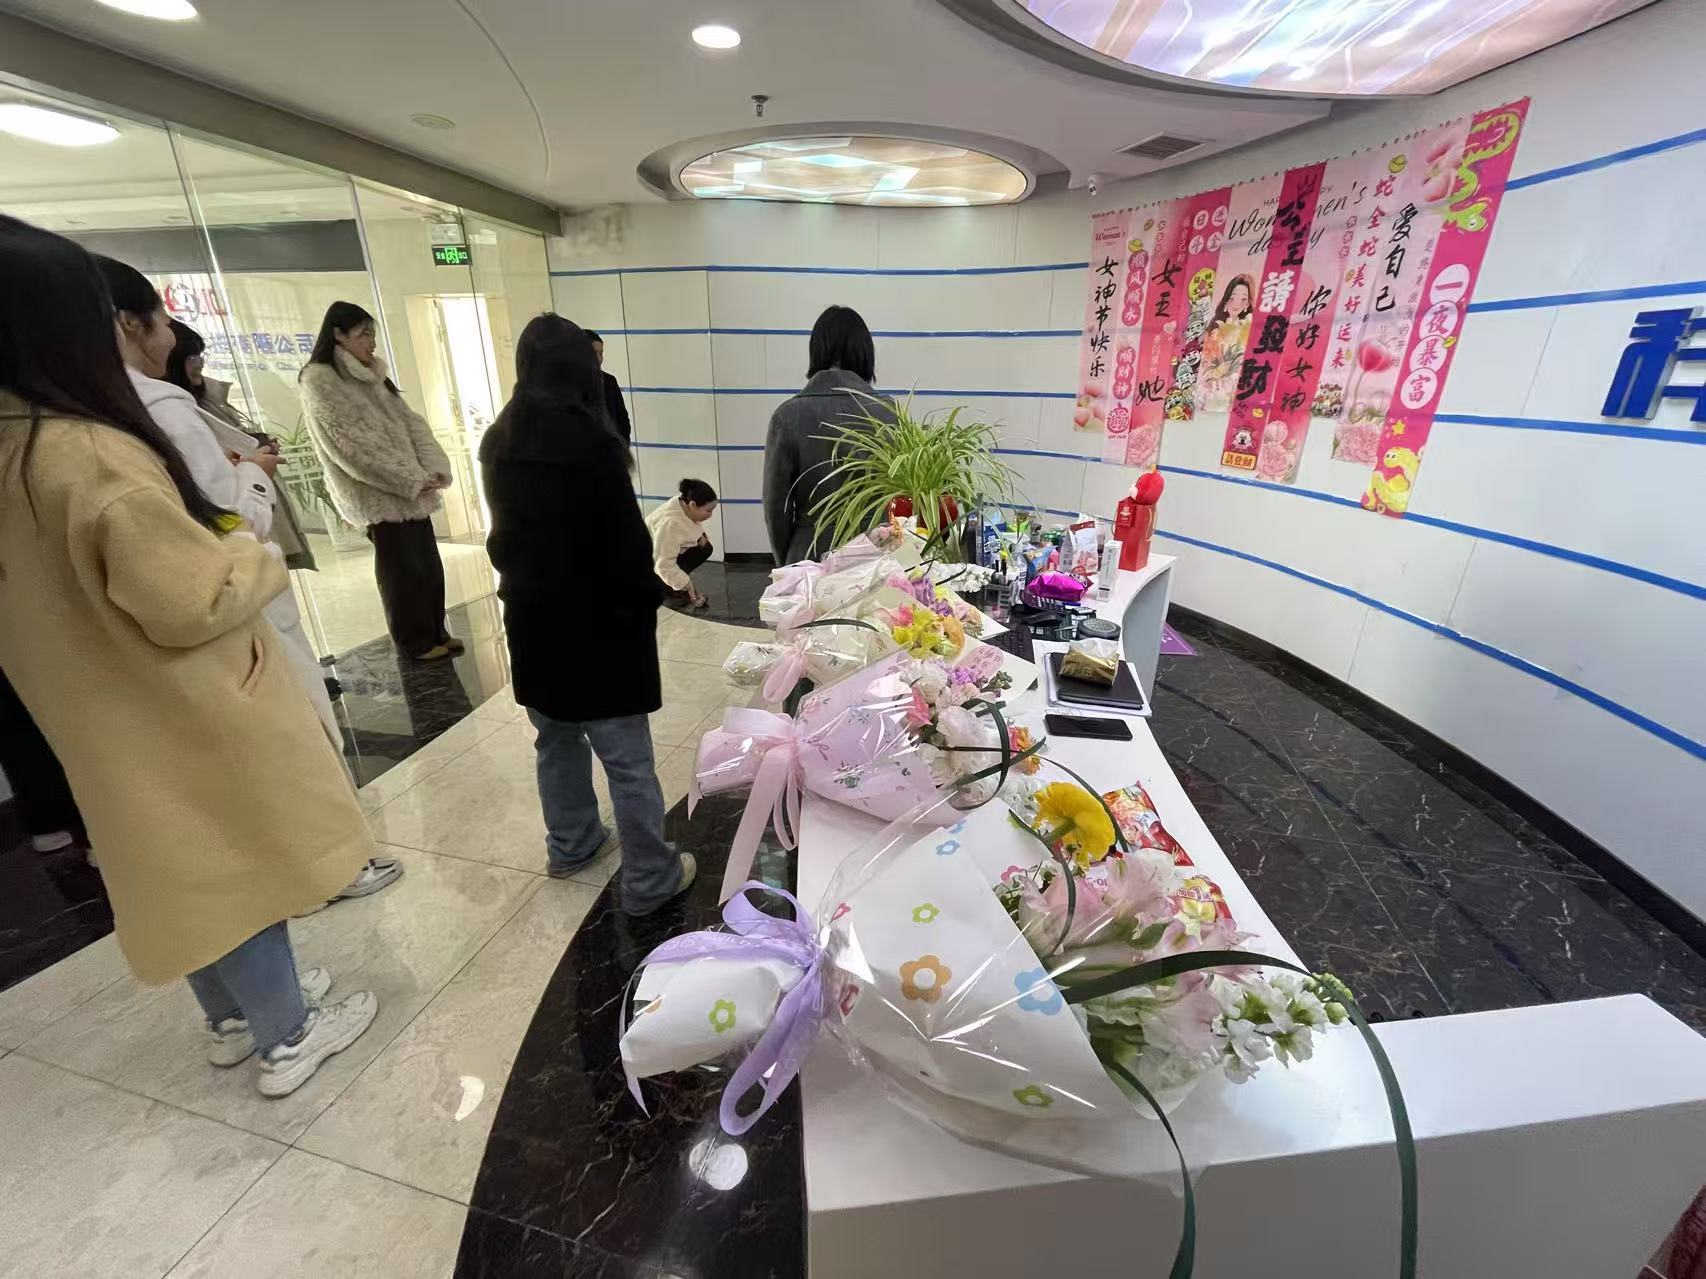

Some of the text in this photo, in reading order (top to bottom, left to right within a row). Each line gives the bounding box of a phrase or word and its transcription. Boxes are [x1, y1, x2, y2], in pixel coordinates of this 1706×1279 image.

[1089, 255, 1119, 378] 女神节快乐
[1279, 284, 1332, 415] 你好女神
[1407, 279, 1463, 403] 一夜暴富
